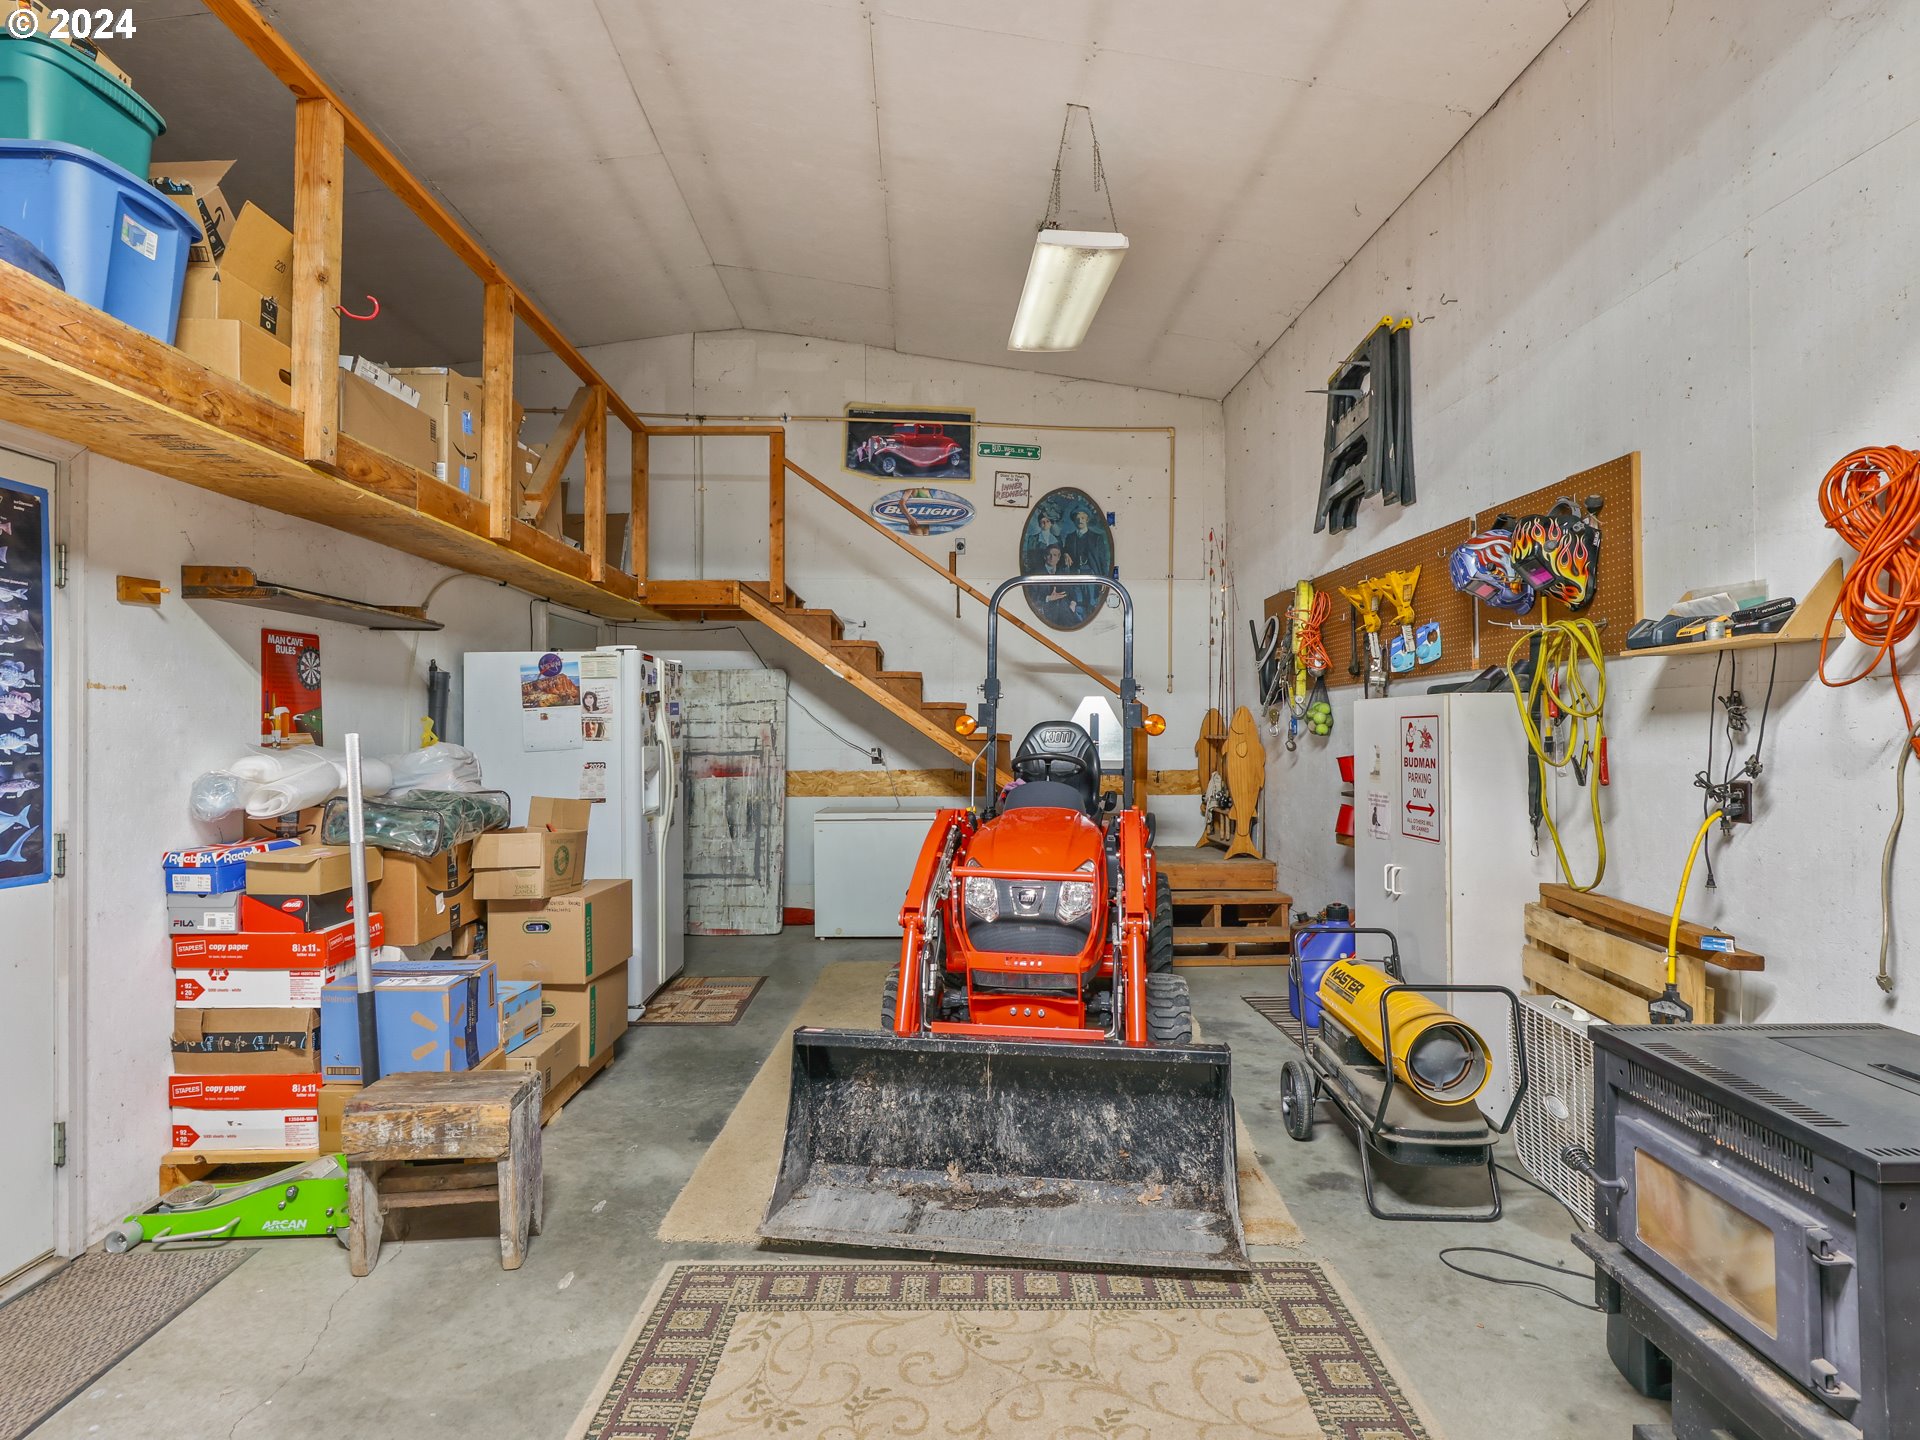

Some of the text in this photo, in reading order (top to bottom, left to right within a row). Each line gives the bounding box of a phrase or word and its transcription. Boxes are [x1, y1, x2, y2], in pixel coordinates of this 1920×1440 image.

[273, 259, 287, 274] 220
[1001, 482, 1023, 491] INNER
[995, 489, 1029, 500] REDNECK
[917, 506, 962, 516] LIGHT
[267, 634, 304, 647] MAN CAVE
[275, 644, 297, 655] RULES
[1044, 730, 1072, 743] KIOTI
[1403, 757, 1436, 769] BUDMAN
[1407, 772, 1432, 784] PARKING
[1412, 787, 1427, 799] ONLY
[169, 852, 212, 864] Reebok
[178, 944, 204, 953] STAPLES
[208, 943, 226, 952] copy
[227, 943, 249, 952] paper
[1328, 966, 1366, 996] MASTER
[175, 1086, 201, 1095] STAPLES
[205, 1084, 223, 1093] copy
[224, 1084, 247, 1093] paper
[261, 1219, 308, 1230] ARCAN
